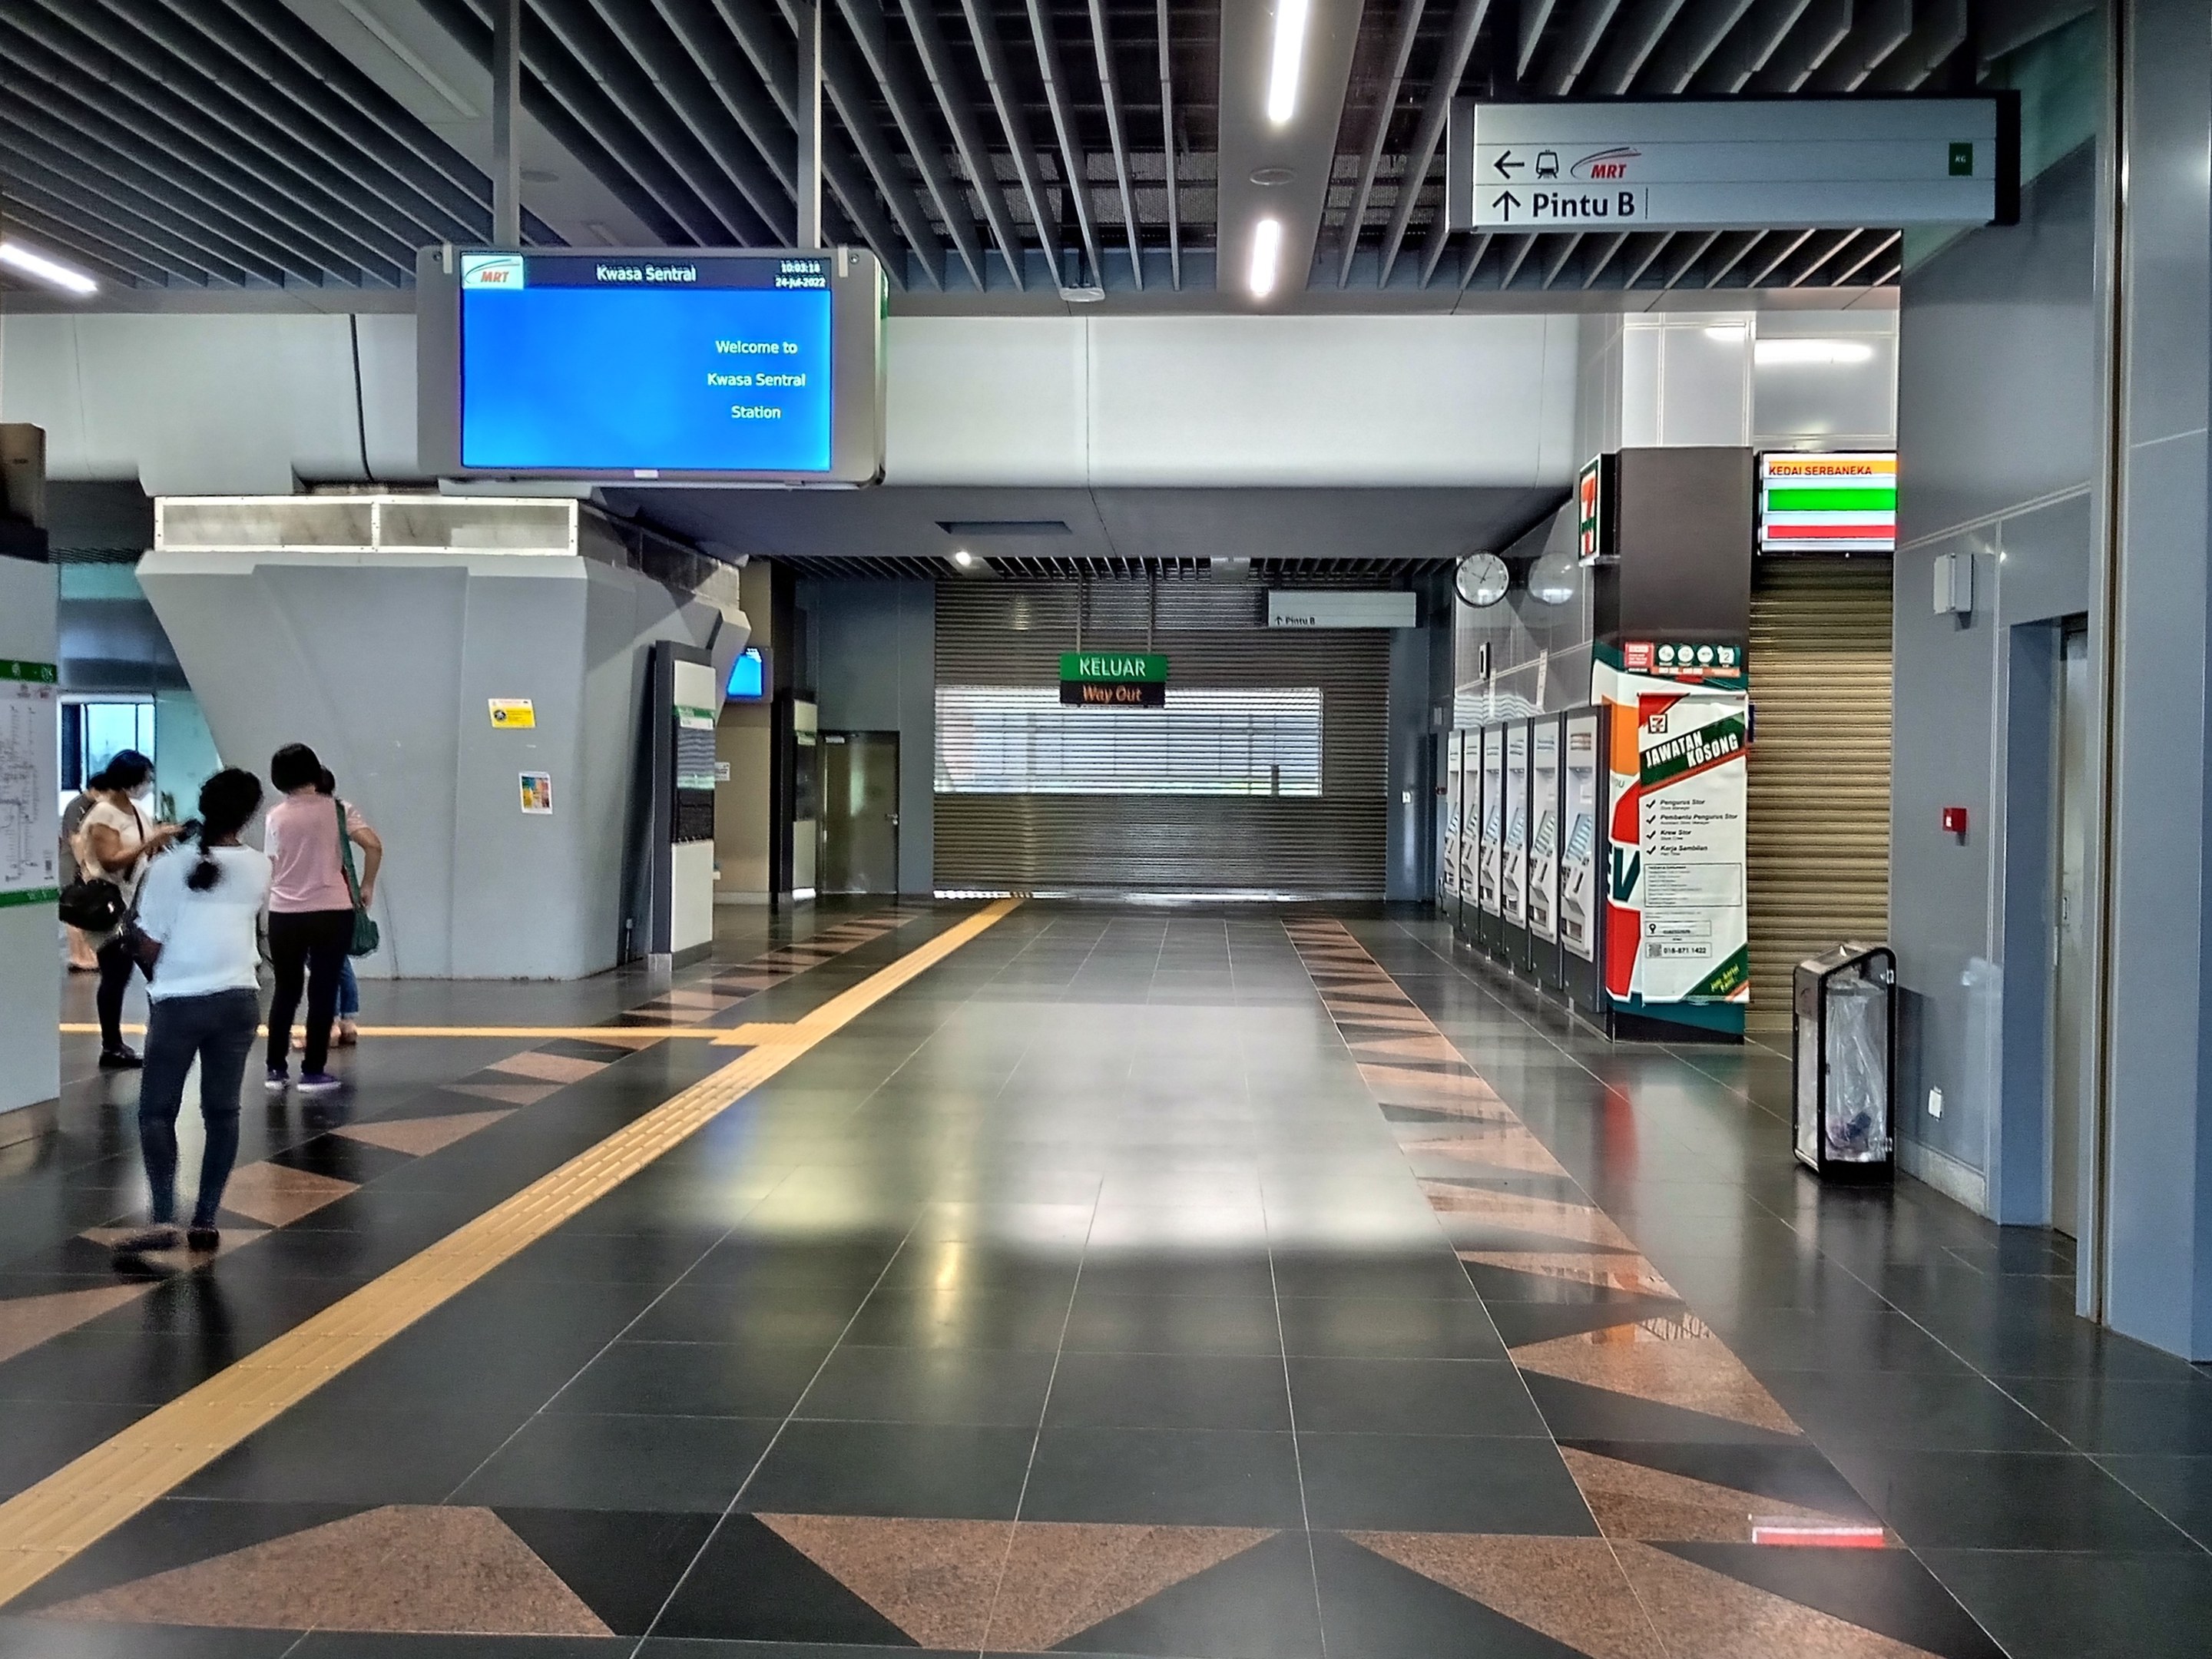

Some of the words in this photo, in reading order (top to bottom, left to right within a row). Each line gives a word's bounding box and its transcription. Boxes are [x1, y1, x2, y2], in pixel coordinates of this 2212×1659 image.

[1591, 164, 1627, 179] MRT
[1532, 192, 1608, 218] Pintu
[1618, 191, 1635, 217] B
[480, 270, 510, 283] MRT
[596, 264, 643, 282] Kwasa
[645, 264, 697, 283] Sentral
[715, 340, 780, 354] Welcome
[783, 341, 799, 355] to
[707, 373, 753, 386] Kwasa
[755, 373, 806, 387] Sentral
[731, 405, 782, 419] Station
[1769, 465, 1803, 475] KEDAI
[1805, 465, 1873, 475] SERBANEKA
[1285, 616, 1308, 625] Pintu
[1310, 617, 1316, 625] B
[1079, 657, 1146, 677] KELUAR
[1082, 684, 1113, 704] Way
[1116, 684, 1143, 702] Out
[1645, 730, 1704, 769] JAWATAN
[1686, 732, 1740, 768] KOSONG
